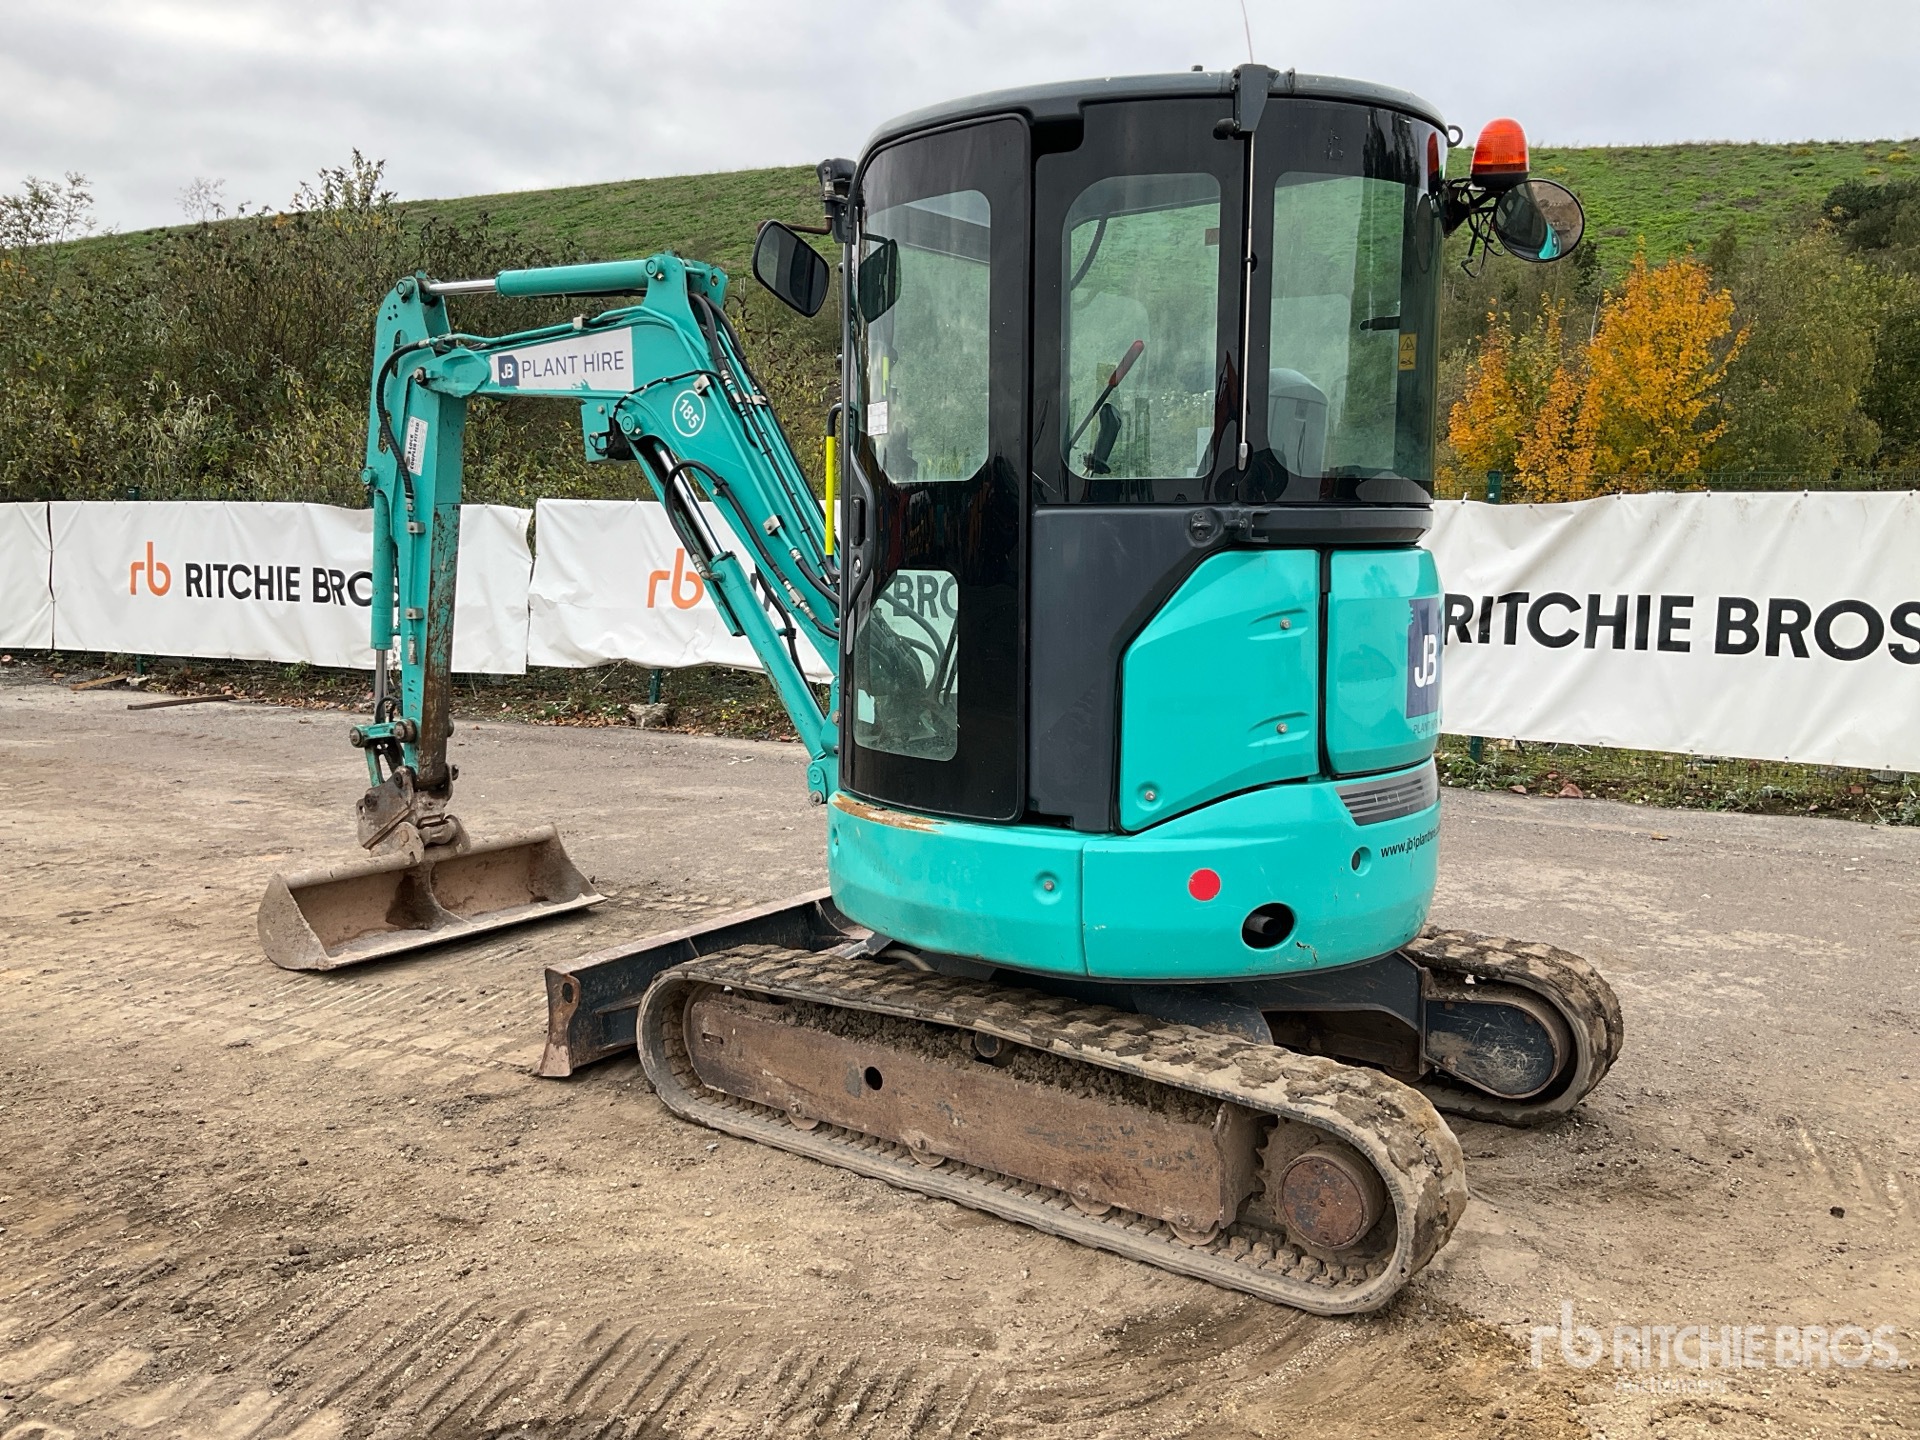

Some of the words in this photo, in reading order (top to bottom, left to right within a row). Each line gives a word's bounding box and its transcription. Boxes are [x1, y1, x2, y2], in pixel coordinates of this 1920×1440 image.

[521, 355, 578, 379] PLANT
[583, 350, 625, 373] HIRE
[679, 399, 701, 428] 185
[130, 541, 171, 597] rb
[185, 562, 301, 603] RITCHIE
[312, 566, 400, 608] BRO
[647, 547, 706, 610] rb
[1444, 592, 1694, 653] RITCHIE
[1715, 596, 1920, 665] BROS
[1414, 633, 1437, 688] JB
